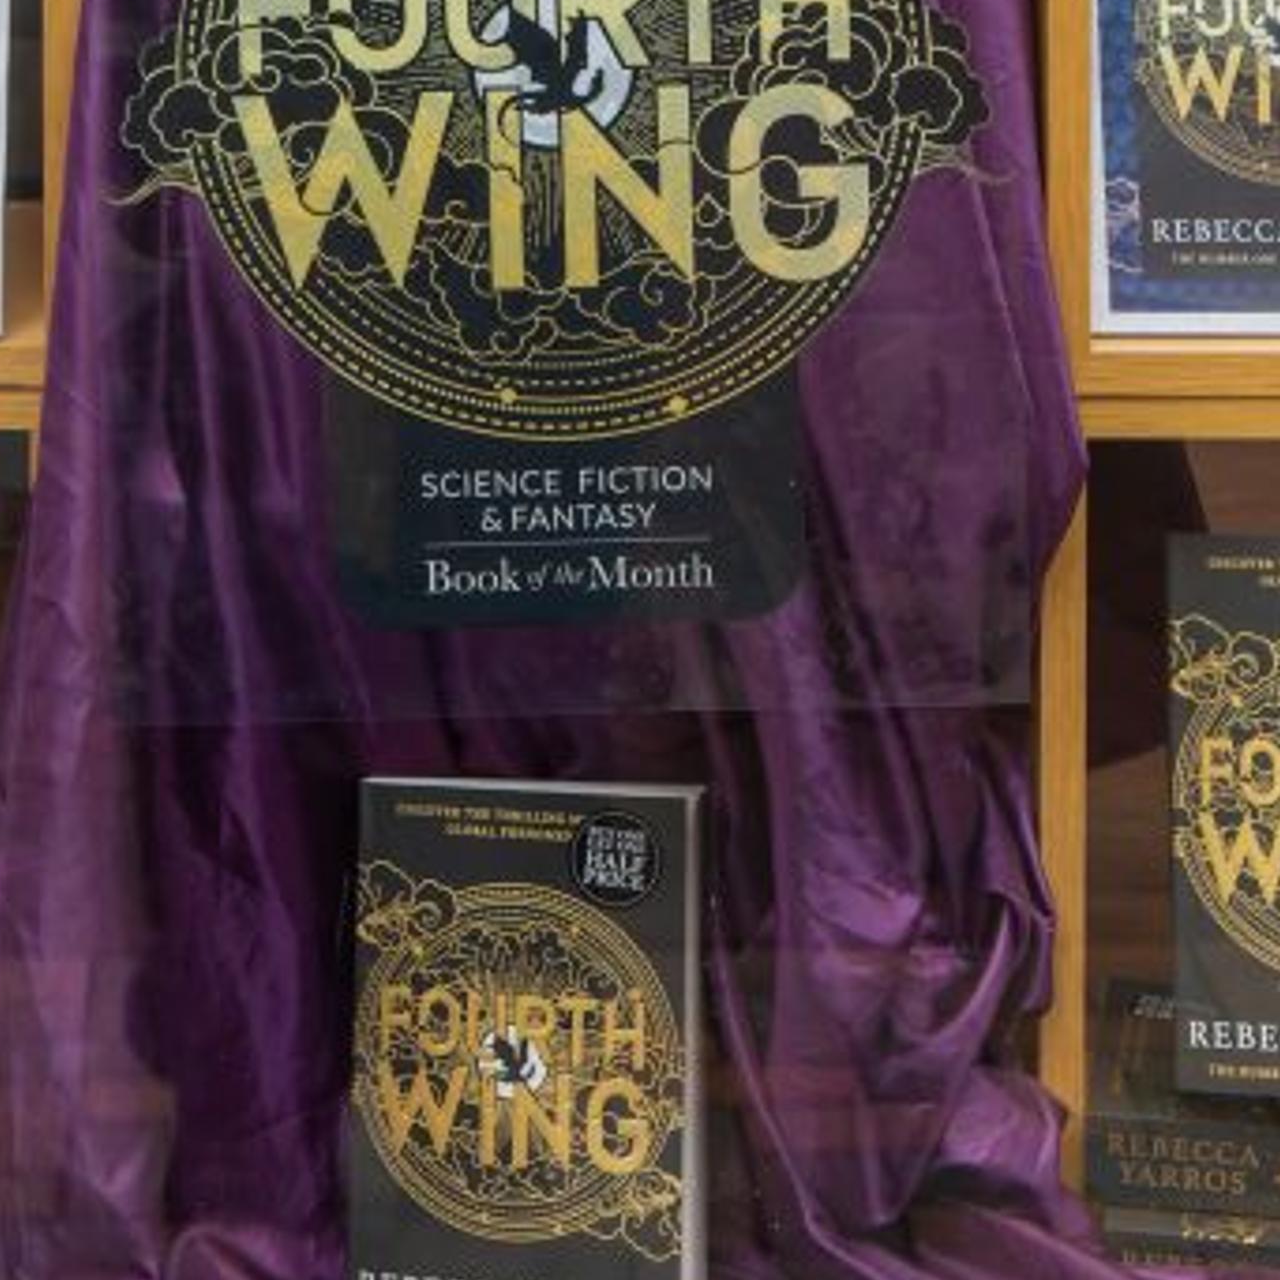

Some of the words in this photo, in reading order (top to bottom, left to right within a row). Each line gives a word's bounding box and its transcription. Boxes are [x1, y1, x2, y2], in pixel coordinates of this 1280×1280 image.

[230, 80, 872, 294] WING
[421, 468, 562, 500] SCIENCE
[578, 464, 714, 495] FICTION
[480, 506, 504, 533] &
[511, 503, 658, 532] FANTASY
[423, 556, 522, 597] Book
[526, 561, 553, 592] of
[554, 560, 588, 587] the
[587, 550, 716, 592] Month
[586, 850, 648, 872] HALF
[378, 984, 646, 1071] FOURTH
[377, 1061, 651, 1174] WING
[1107, 1131, 1261, 1170] REBECCA
[1119, 1159, 1248, 1196] YARROS
